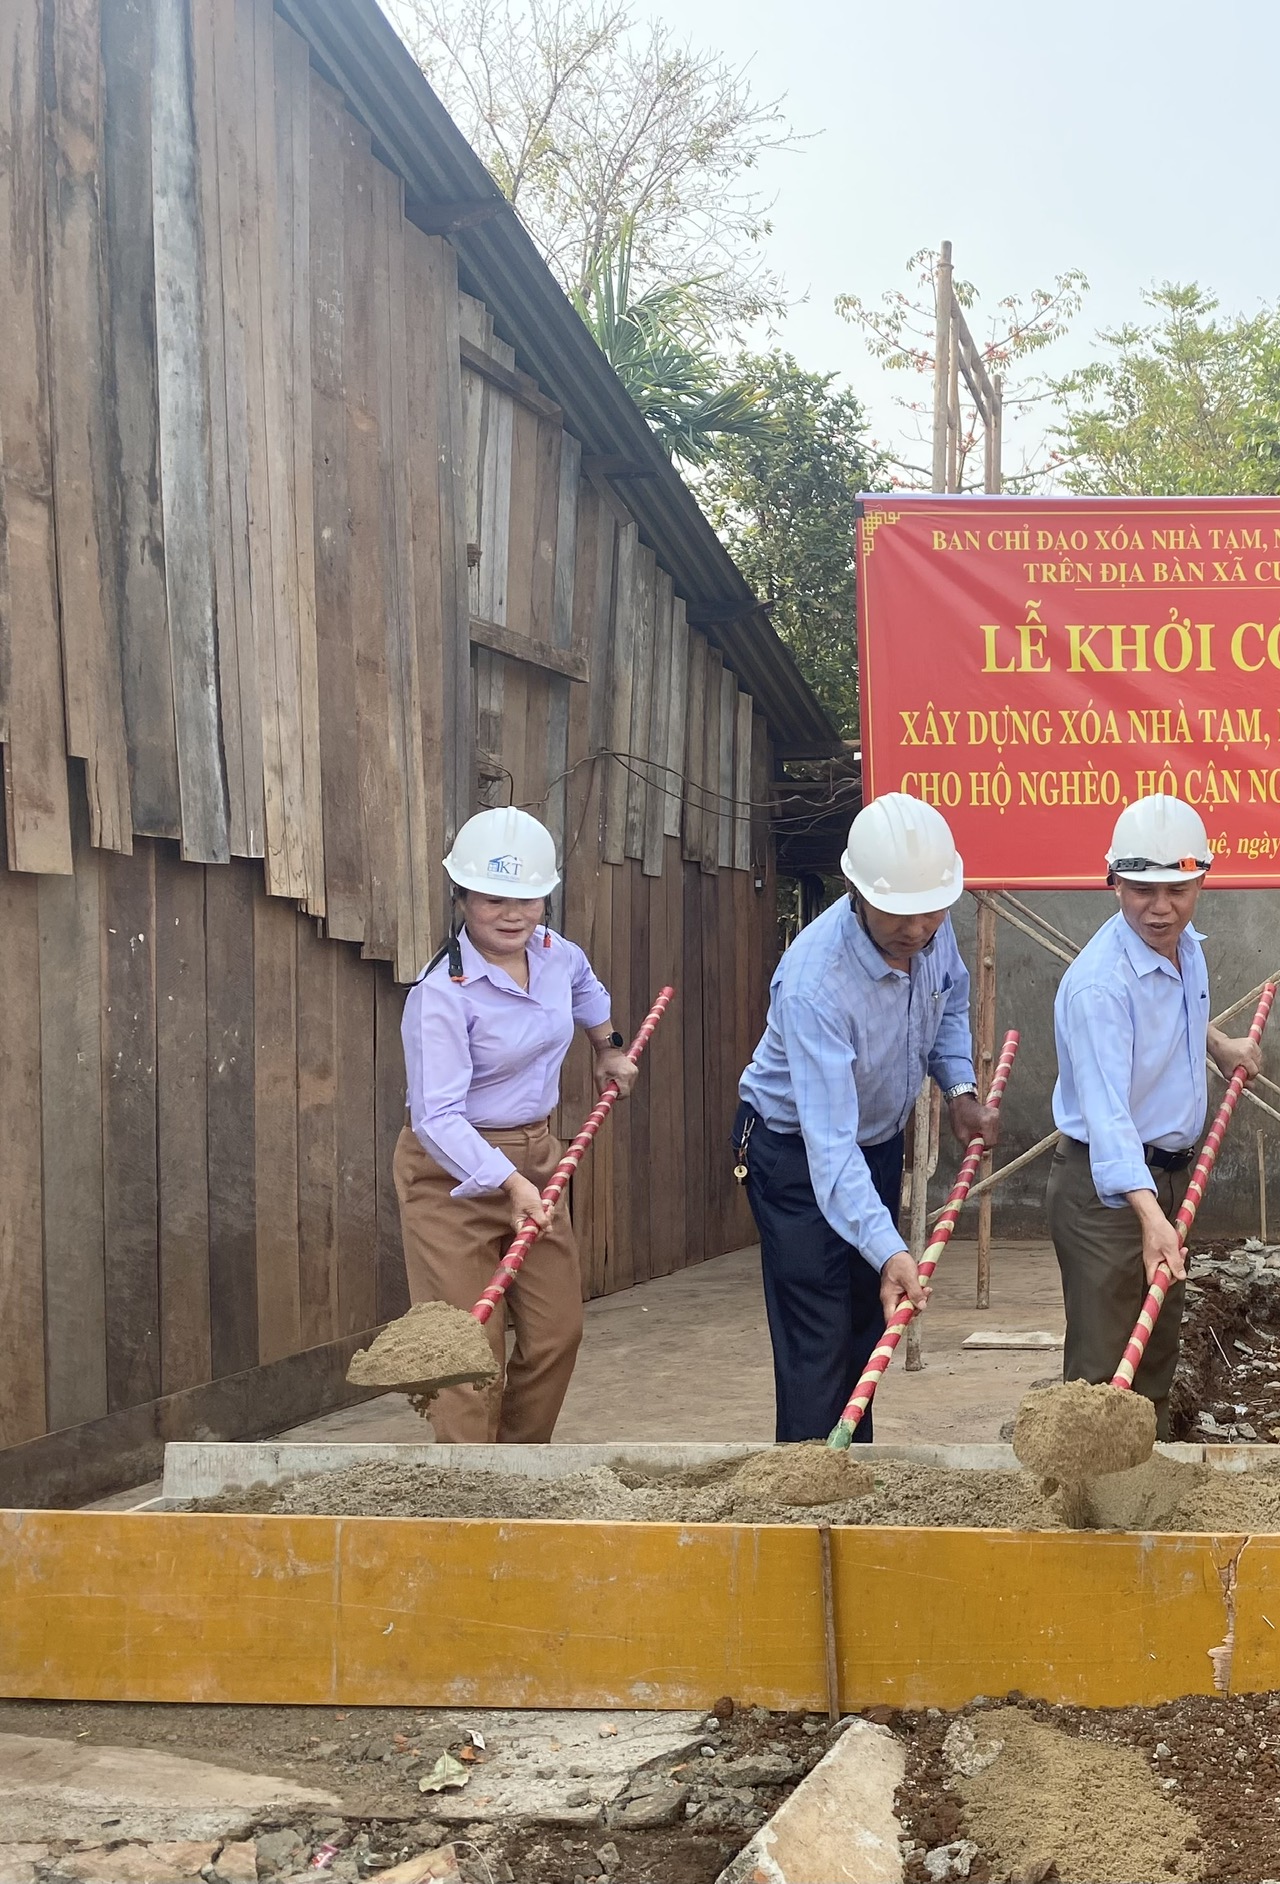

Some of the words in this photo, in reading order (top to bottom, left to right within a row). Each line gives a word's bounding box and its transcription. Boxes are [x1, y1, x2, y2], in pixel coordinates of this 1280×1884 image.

[931, 529, 981, 551] BAN
[986, 523, 1031, 551] CHỈ
[1036, 529, 1089, 556] ĐẠO
[1094, 523, 1145, 550] XÓA
[1151, 523, 1202, 550] NHÀ
[1208, 528, 1268, 555] TẠM,
[1023, 556, 1093, 584] TRÊN
[1099, 562, 1146, 588] ĐỊA
[1152, 556, 1205, 583] BÀN
[1211, 556, 1248, 582] XÃ
[980, 599, 1052, 673] LỄ
[1064, 607, 1217, 673] KHỞI
[899, 700, 961, 746] XÂY
[966, 704, 1053, 755] DỰNG
[1058, 698, 1123, 745] XÓA
[1127, 698, 1195, 744] NHÀ
[1198, 708, 1271, 752] TẠM,
[900, 771, 963, 807] CHO
[968, 761, 1013, 815] HỘ
[1017, 760, 1130, 810] NGHÈO,
[1184, 759, 1242, 813] CẬN
[1206, 831, 1232, 859] uê,
